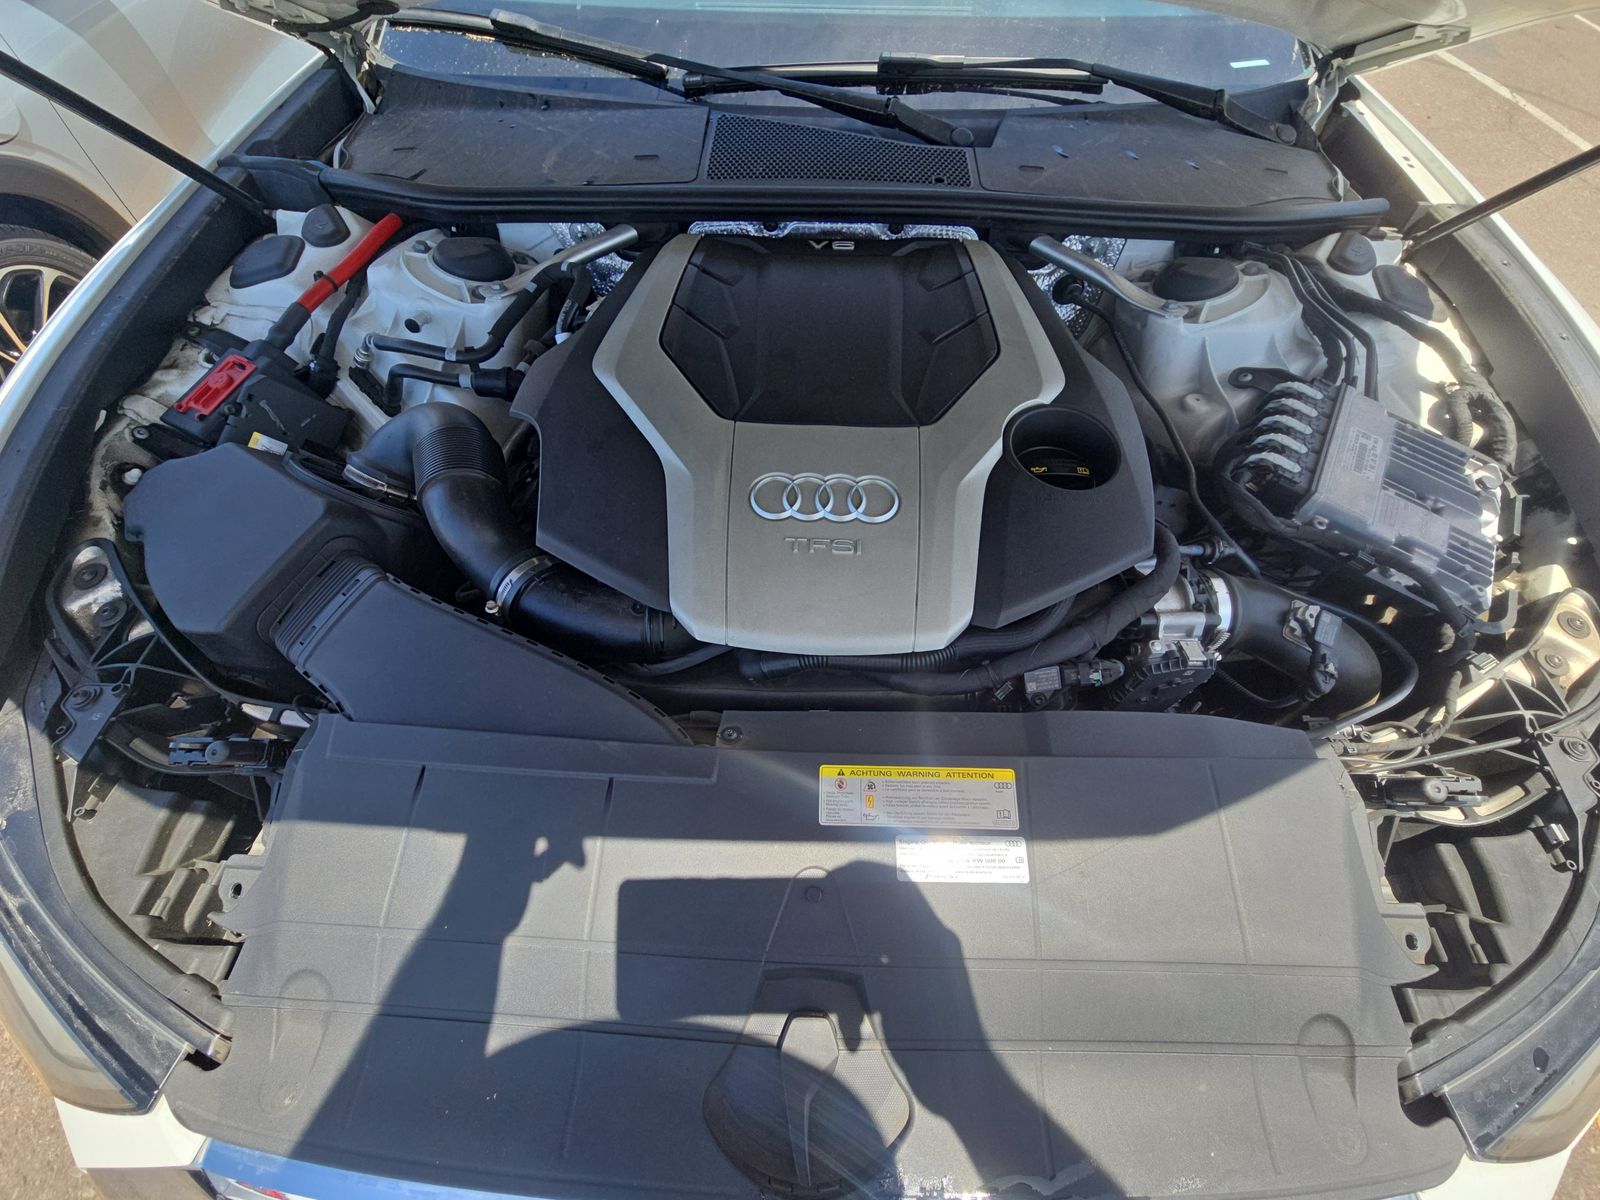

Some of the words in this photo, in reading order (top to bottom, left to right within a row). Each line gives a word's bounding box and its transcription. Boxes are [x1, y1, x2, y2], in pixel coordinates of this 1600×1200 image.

[808, 240, 855, 251] V6
[784, 537, 862, 556] TFSI
[849, 769, 892, 777] ACHTUNG
[896, 770, 941, 778] WARNING
[945, 771, 994, 779] ATTENTION
